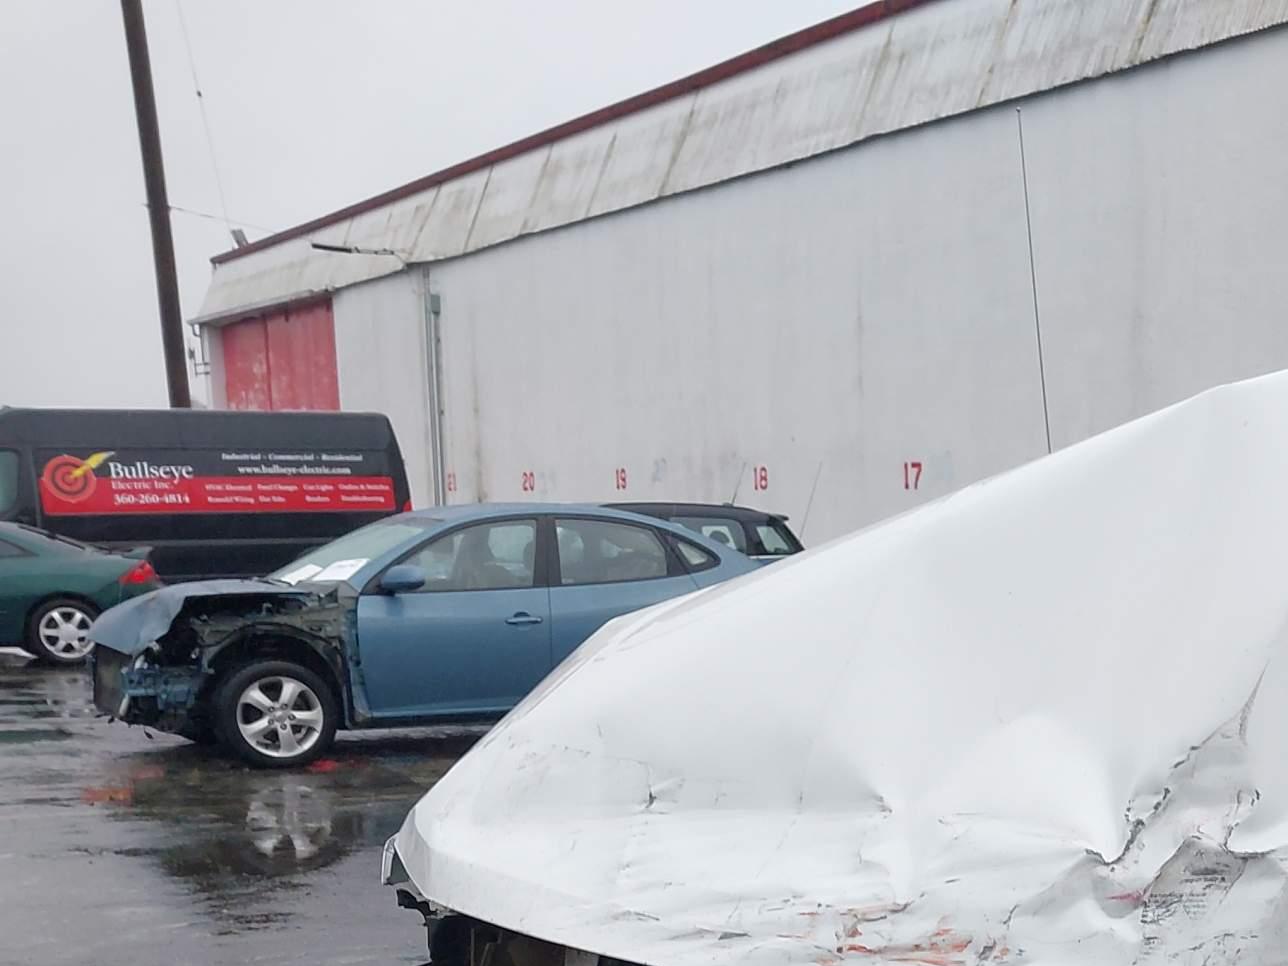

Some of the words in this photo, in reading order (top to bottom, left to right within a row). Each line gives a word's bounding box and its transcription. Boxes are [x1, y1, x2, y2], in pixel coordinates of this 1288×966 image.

[108, 461, 193, 485] Bullseye
[522, 472, 535, 491] 20
[615, 468, 627, 490] 19
[753, 466, 768, 491] 18
[903, 461, 923, 490] 17
[111, 480, 151, 490] Electric
[154, 480, 175, 490] Inc.
[114, 494, 190, 505] 360-260-4814
